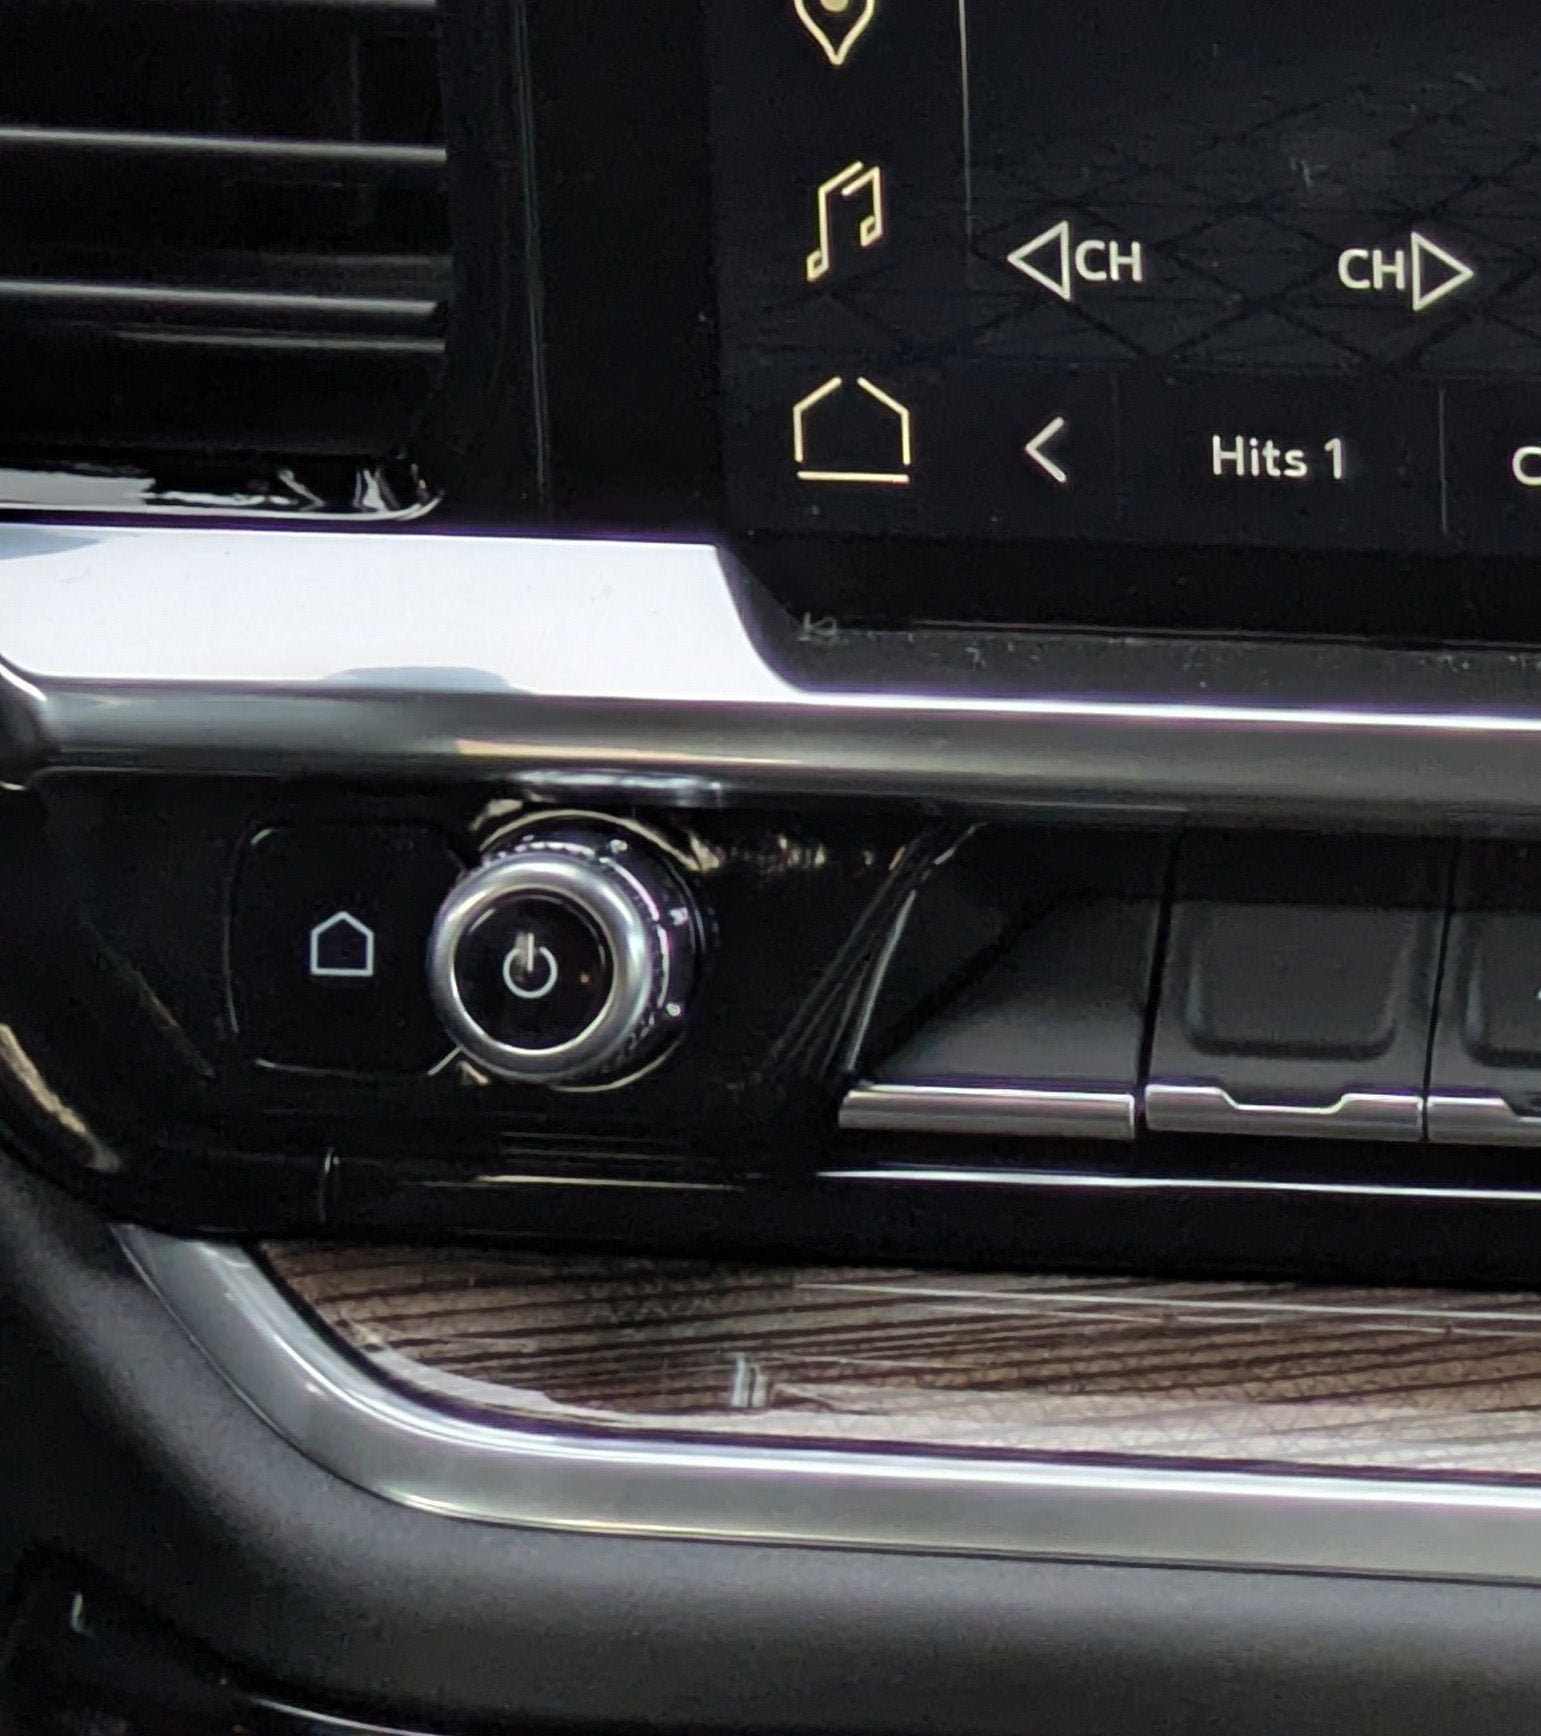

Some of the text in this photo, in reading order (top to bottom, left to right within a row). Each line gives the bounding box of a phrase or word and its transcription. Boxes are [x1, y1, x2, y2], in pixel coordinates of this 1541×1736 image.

[1074, 239, 1143, 282] CH
[1338, 248, 1406, 290] CH
[1212, 435, 1343, 479] Hits 1
